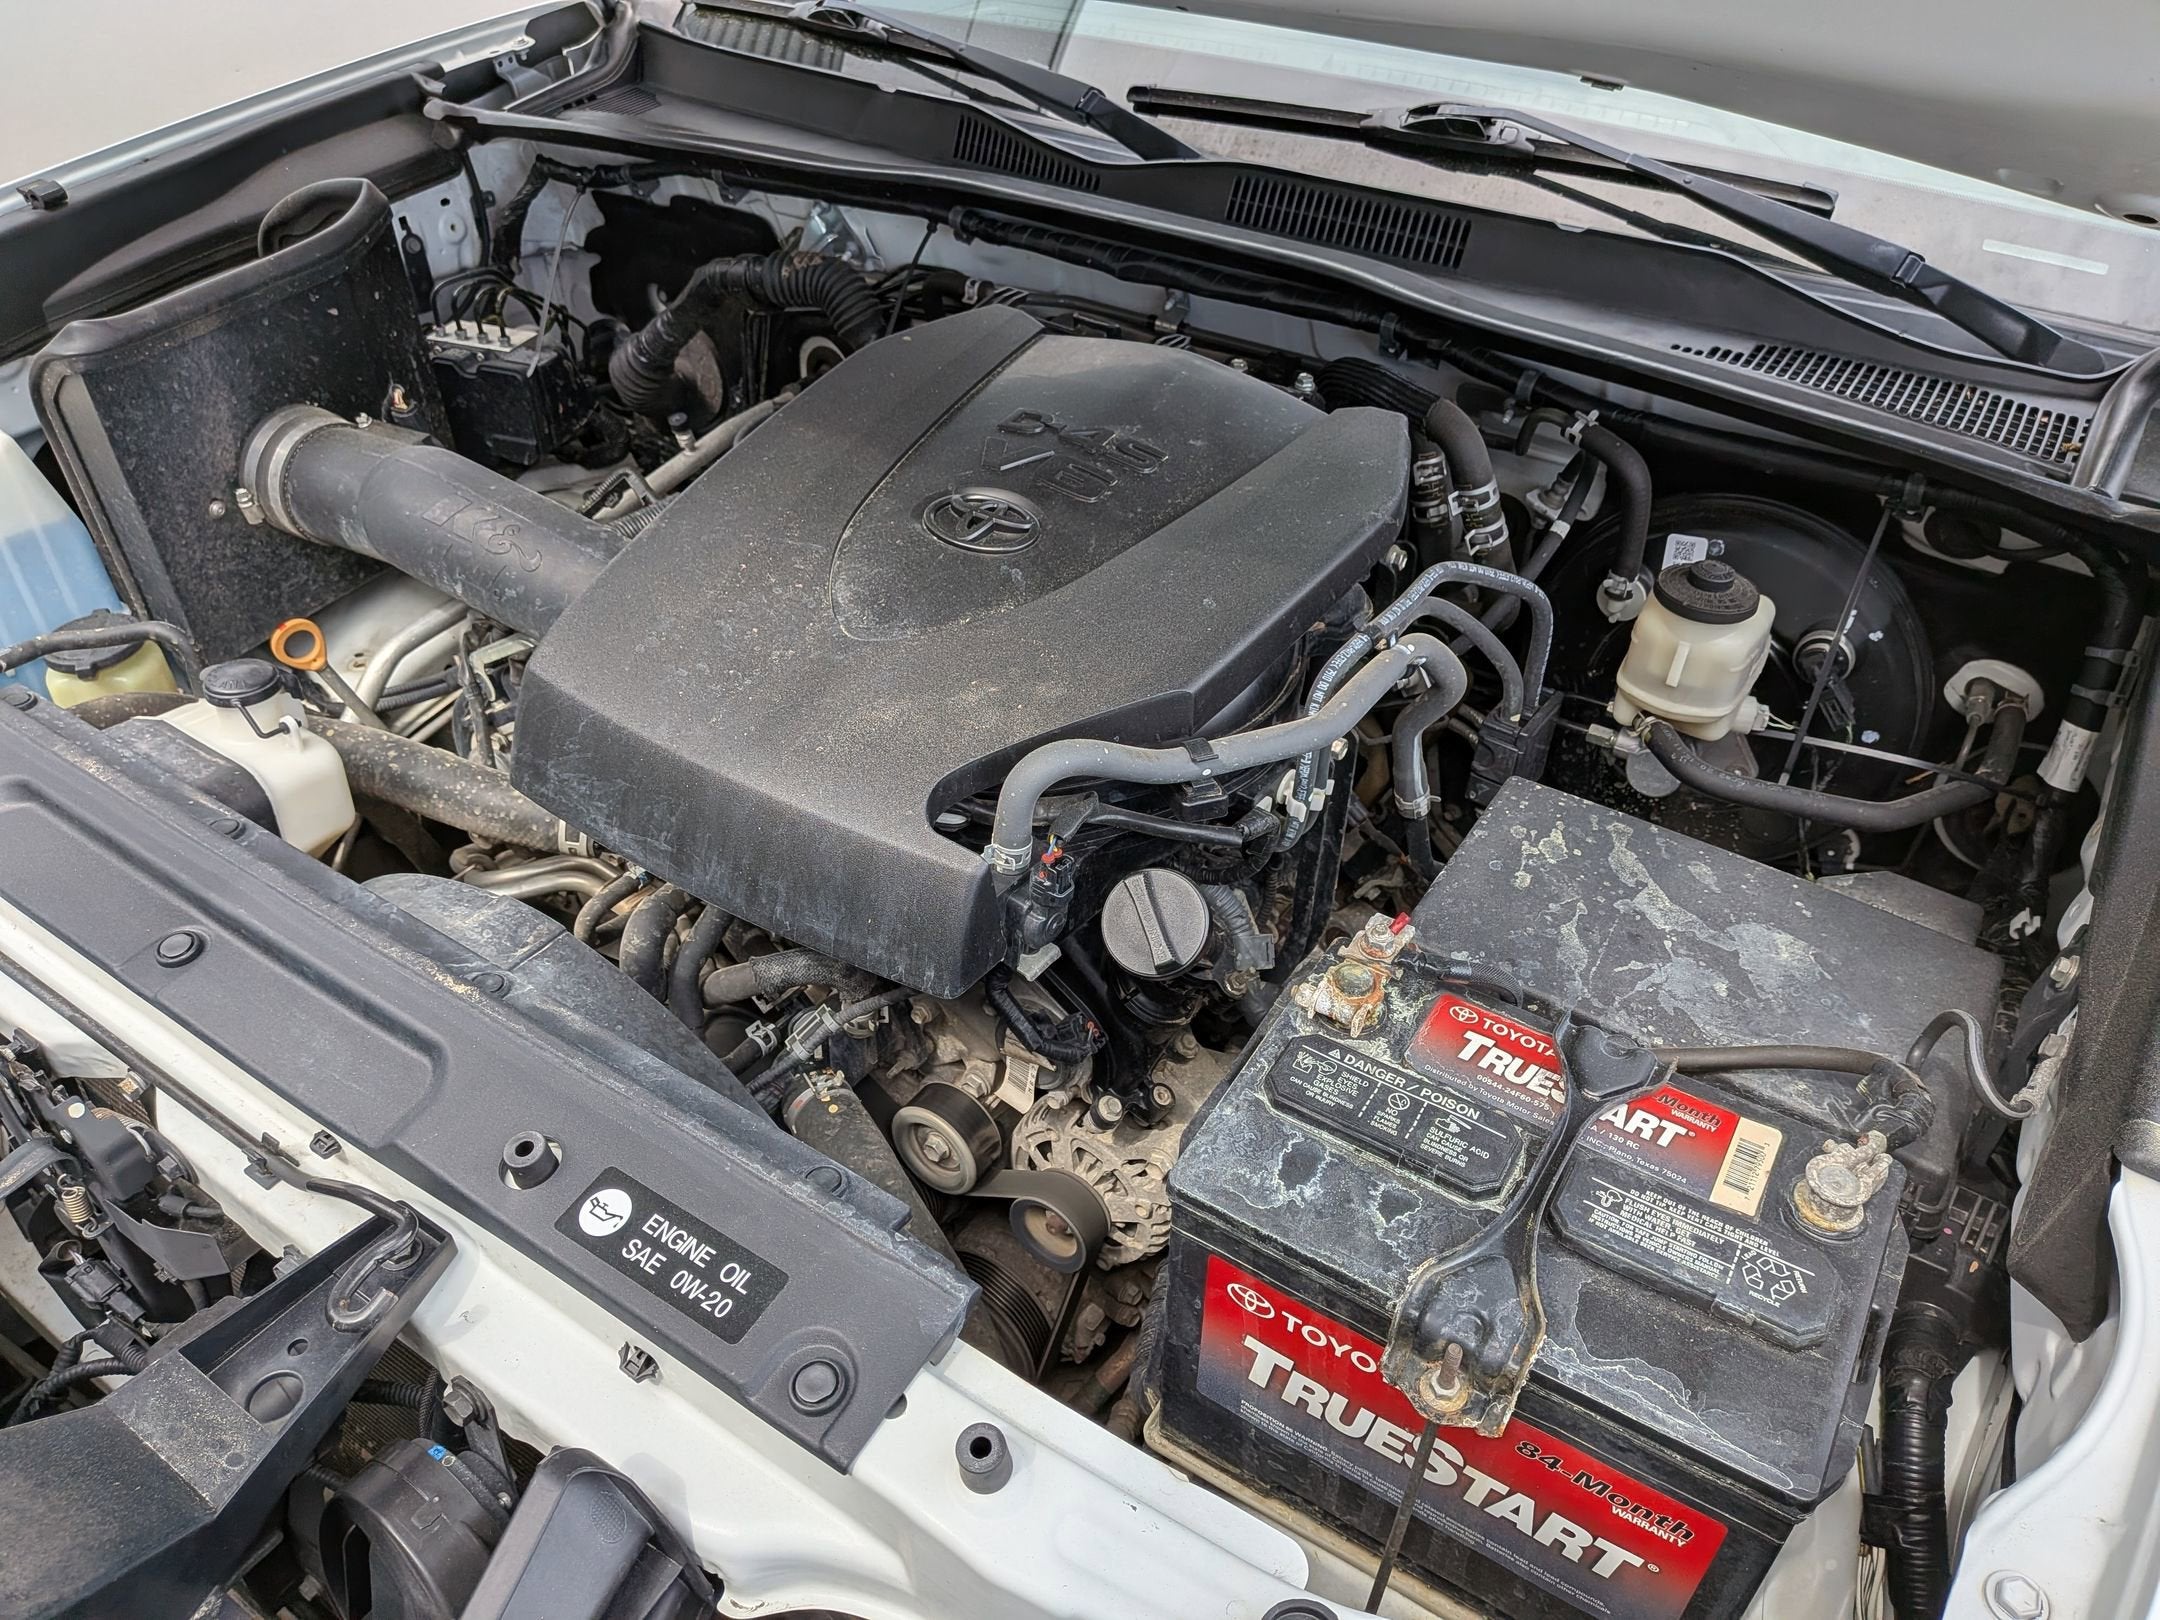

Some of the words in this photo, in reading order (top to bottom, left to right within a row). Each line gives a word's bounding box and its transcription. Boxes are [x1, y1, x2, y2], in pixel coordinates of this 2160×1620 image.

[1290, 1076, 1303, 1085] CAN
[1302, 1082, 1322, 1094] CAUSE
[1321, 1090, 1354, 1109] BLINDNESS
[1312, 1079, 1339, 1095] GASES
[1315, 1073, 1359, 1097] EXPLOSIVE
[1336, 1076, 1358, 1090] EYES
[1340, 1070, 1369, 1088] SHIELD
[1343, 1052, 1406, 1088] DANGER
[1419, 1086, 1480, 1121] POISON
[1373, 1115, 1397, 1129] FLAMES
[1376, 1110, 1400, 1124] SPARKS
[1385, 1106, 1398, 1116] NO
[1424, 1063, 1467, 1086] Distributed
[1467, 1083, 1478, 1091] by
[1477, 1087, 1505, 1104] Toyota
[1506, 1100, 1531, 1115] Motor
[1635, 1157, 1660, 1171] Texas
[1660, 1167, 1687, 1183] 75024
[1671, 1109, 1718, 1133] WARRANTY
[1422, 1137, 1457, 1157] BLINDNESS
[1458, 1154, 1468, 1162] OR
[1425, 1132, 1440, 1142] CAN
[1440, 1139, 1462, 1152] CAUSE
[1428, 1126, 1468, 1148] SULFURIC
[1471, 1146, 1490, 1160] ACID
[1607, 1132, 1624, 1143] 130
[1625, 1140, 1640, 1150] RC
[1419, 1143, 1443, 1157] SEVERE
[1444, 1154, 1466, 1168] BURNS
[1619, 1209, 1654, 1229] MEDICAL
[1654, 1225, 1675, 1238] HELP
[1676, 1234, 1696, 1248] FAST
[1622, 1203, 1643, 1217] WITH
[1674, 1226, 1691, 1238] GET
[1624, 1197, 1650, 1213] FLUSH
[1650, 1208, 1671, 1222] EYES
[1671, 1217, 1724, 1245] IMMEDIATELY
[641, 1214, 717, 1269] ENGINE
[720, 1262, 752, 1296] OIL
[621, 1238, 667, 1275] SAE
[670, 1270, 733, 1318] 0W-20
[1749, 1290, 1780, 1308] RECYCLE
[1281, 1311, 1390, 1382] TOYO
[1239, 1398, 1285, 1428] PROPOSITION
[1515, 1441, 1695, 1541] 84-Month
[1611, 1507, 1687, 1547] WARRANTY
